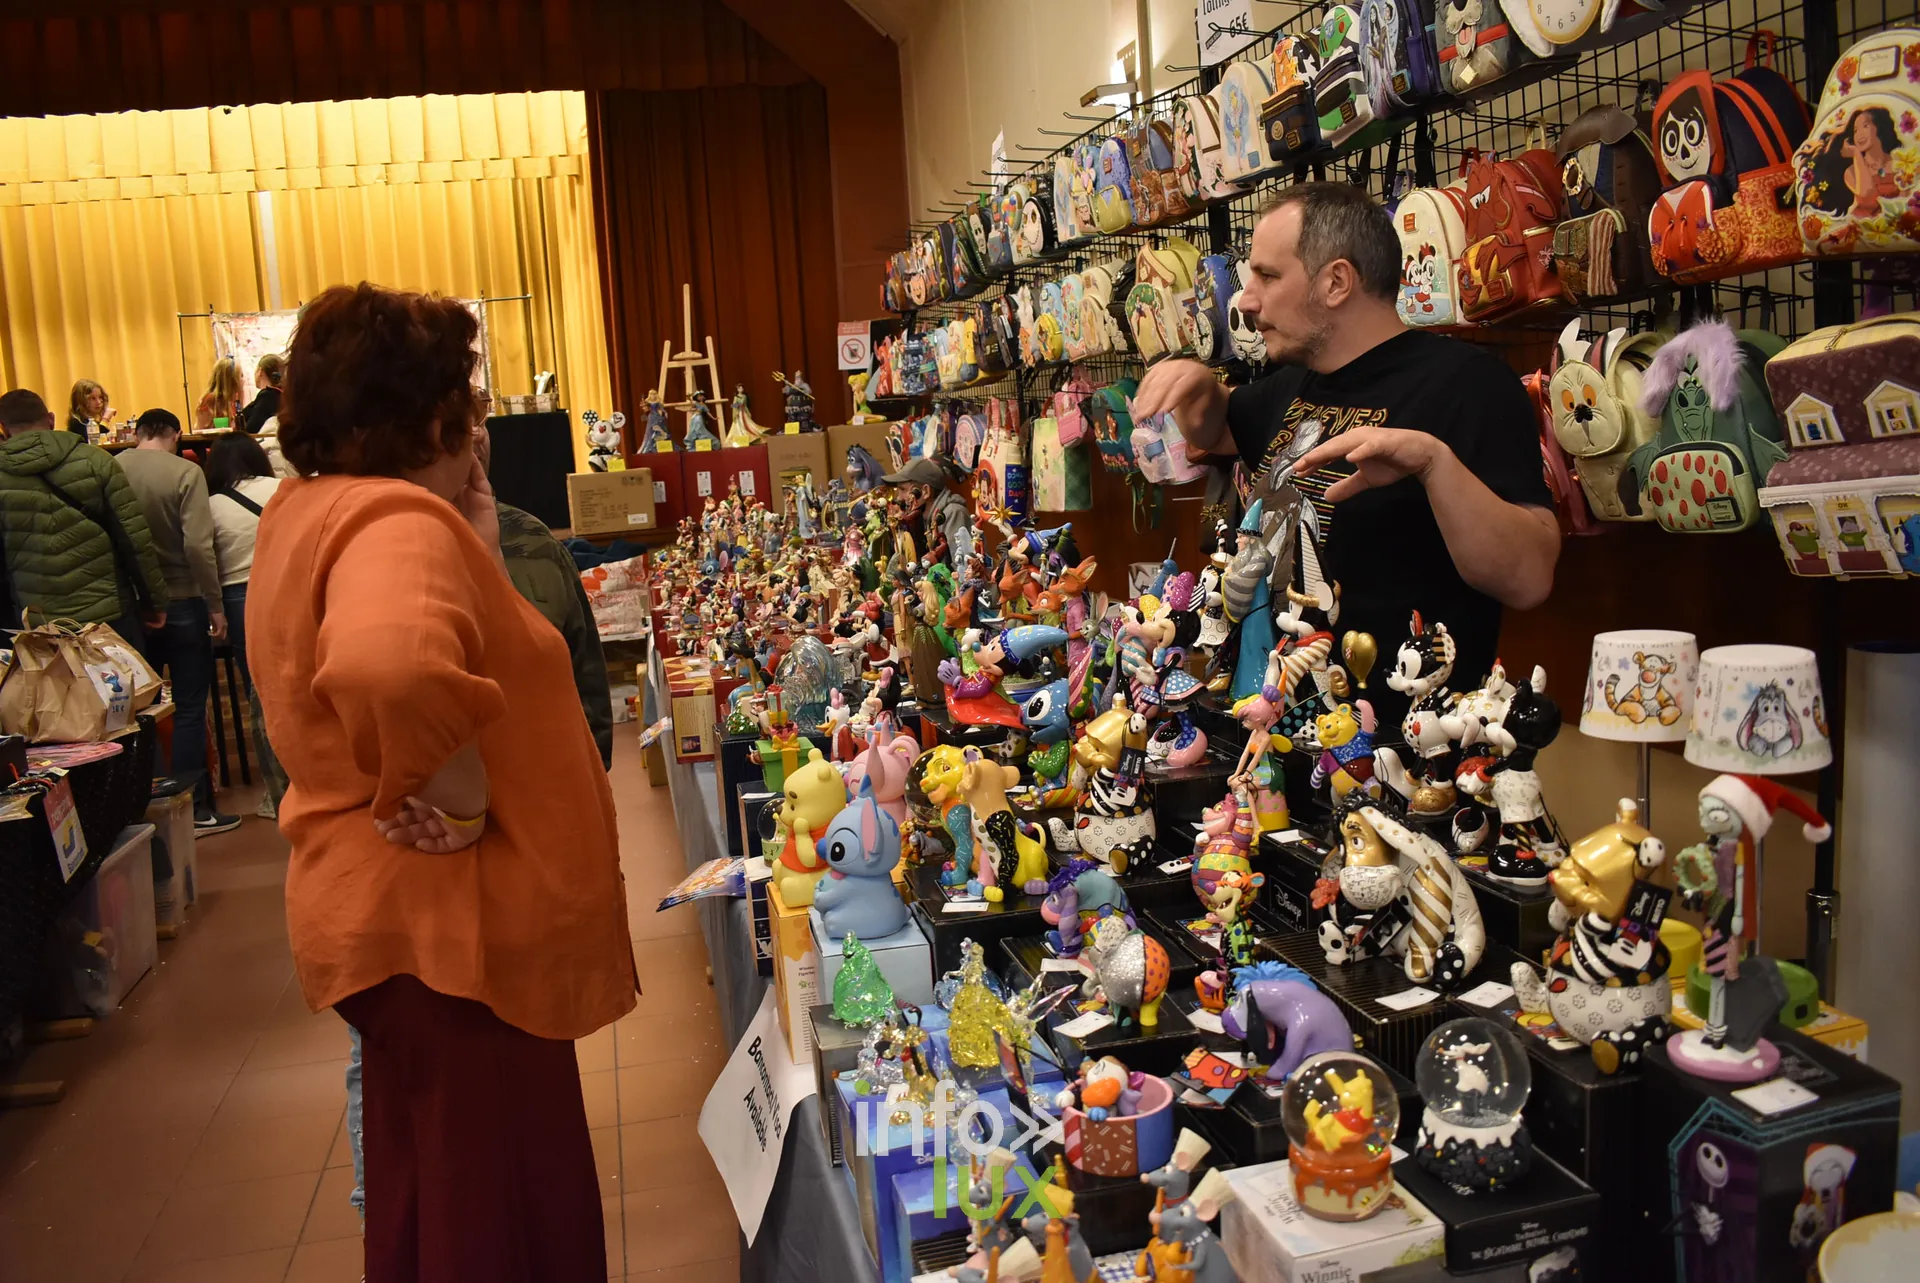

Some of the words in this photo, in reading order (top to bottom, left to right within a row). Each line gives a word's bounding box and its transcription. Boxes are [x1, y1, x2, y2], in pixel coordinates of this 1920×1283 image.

[1536, 4, 1542, 15] 8
[1545, 15, 1551, 27] 7
[1570, 11, 1576, 23] 5
[1557, 18, 1564, 30] 6
